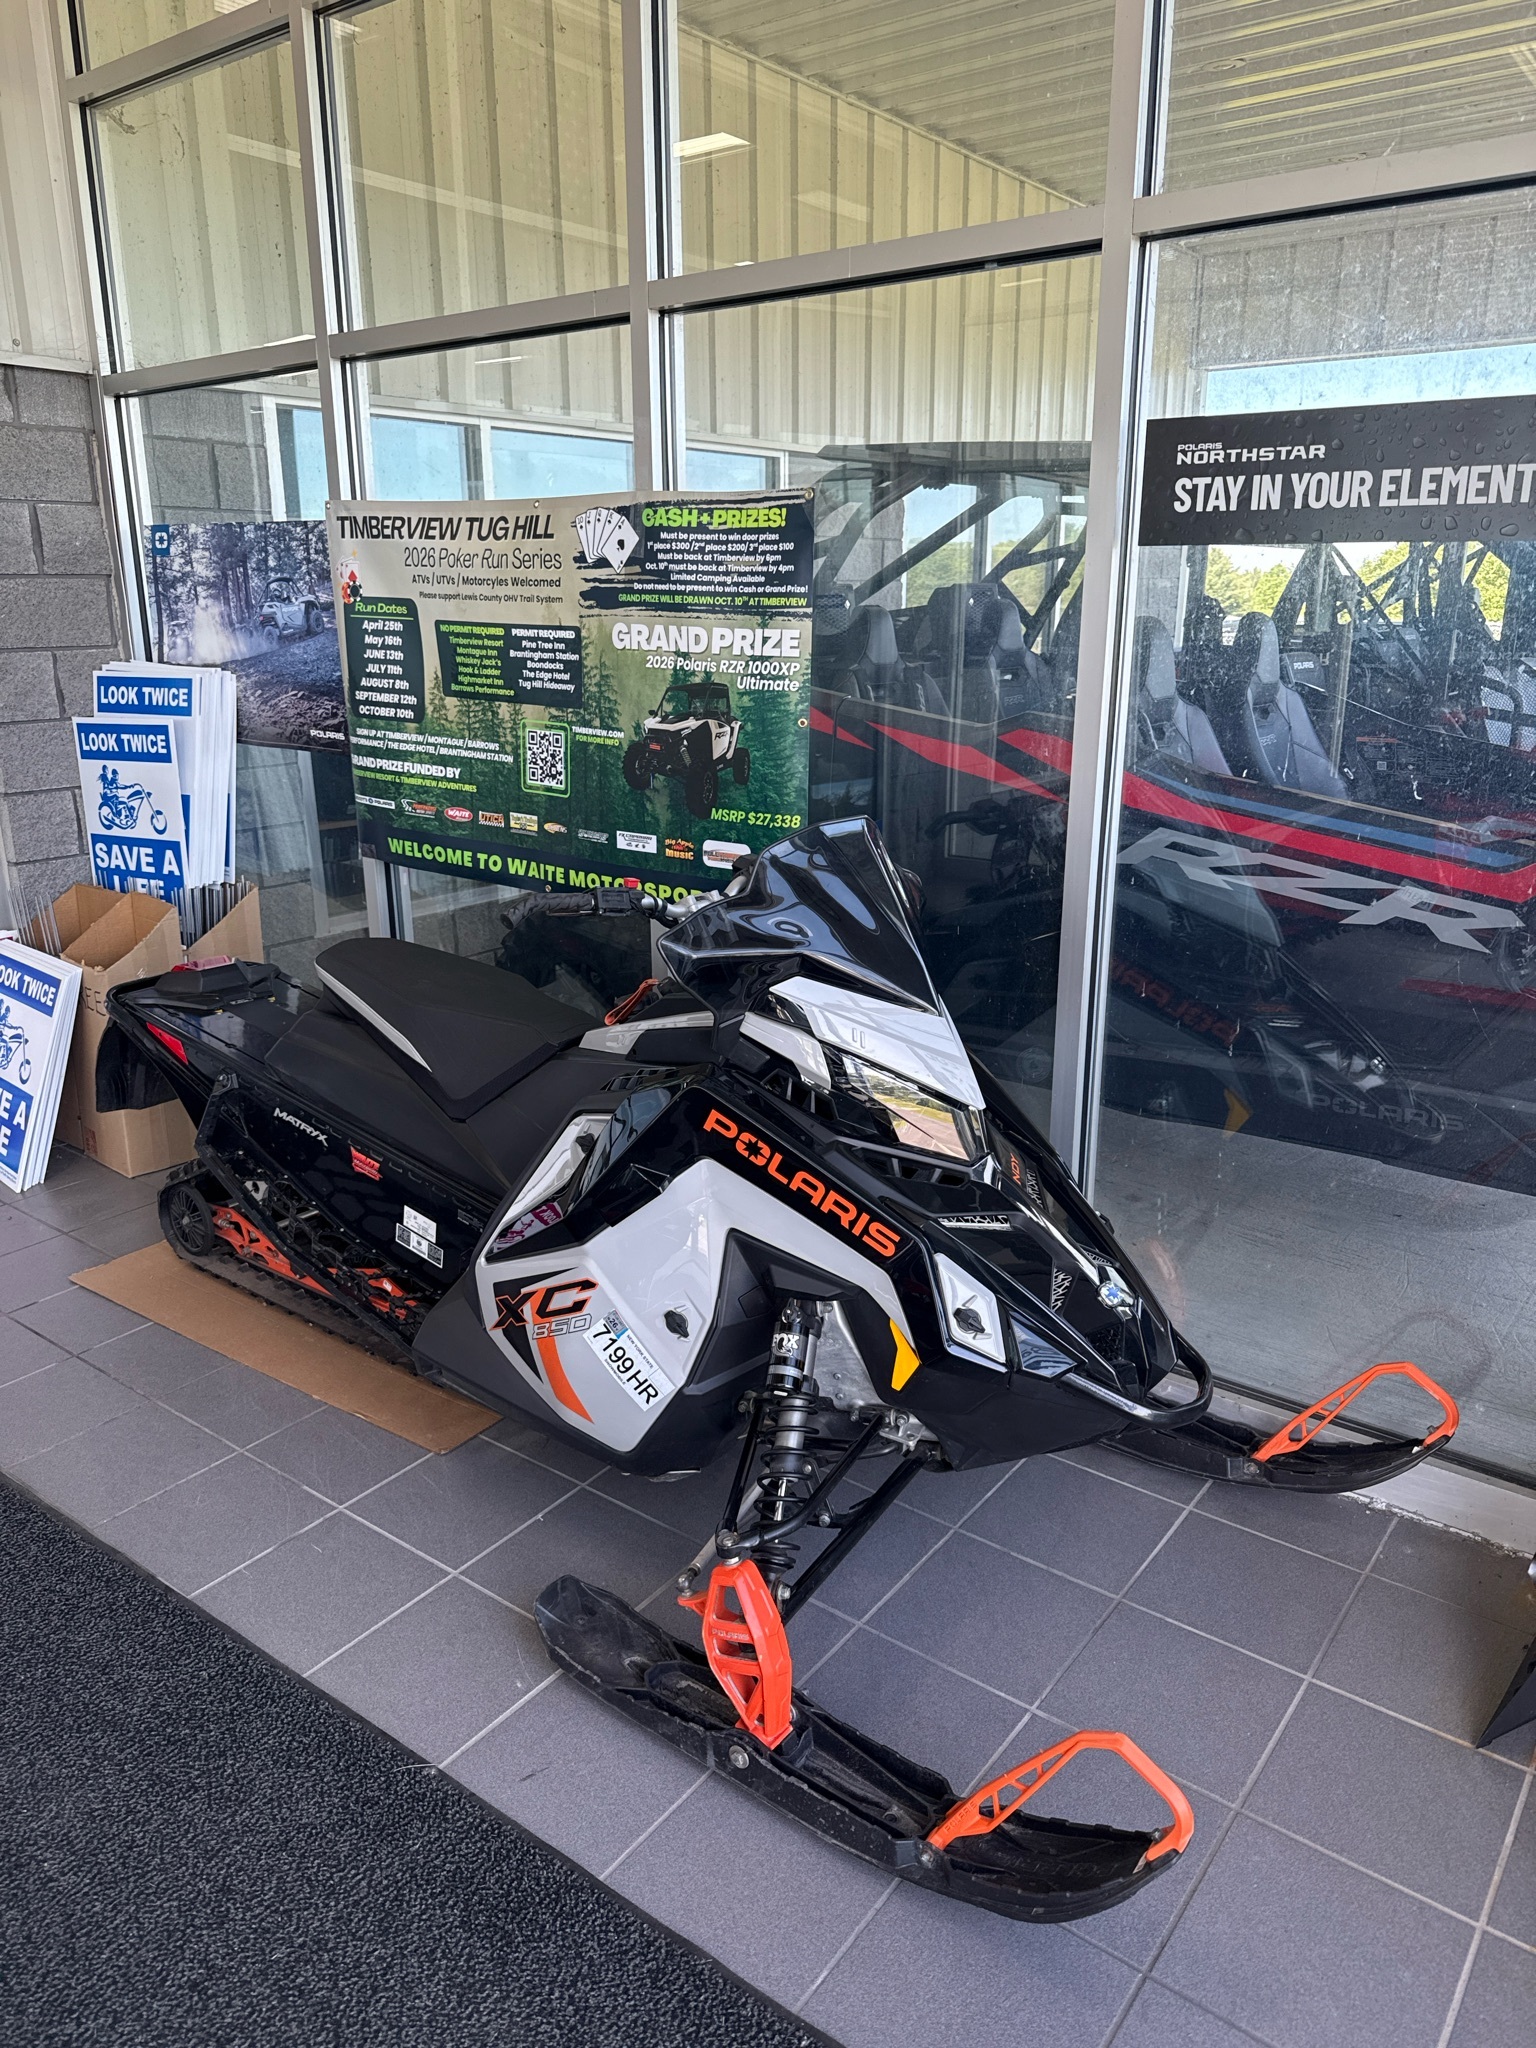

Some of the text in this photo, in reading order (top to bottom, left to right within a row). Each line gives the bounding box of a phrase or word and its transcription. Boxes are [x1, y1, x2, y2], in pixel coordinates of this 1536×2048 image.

[1177, 442, 1223, 452] POLARIS
[1176, 444, 1325, 465] NORTHSTAR
[1173, 463, 1536, 513] STAY IN YOUR ELEMENT
[641, 507, 698, 527] CASH
[712, 507, 787, 528] PRIZES!
[336, 515, 462, 541] TIMBERVIEW
[465, 516, 510, 541] TUG
[511, 514, 555, 540] HILL
[660, 531, 780, 542] Must be present win door prizes
[653, 541, 795, 553] place $300 place place $100
[404, 547, 562, 570] 2026 Poker Run Series
[657, 552, 782, 563] Must back Timberview 6pm
[668, 563, 795, 574] must Timberview 4pm
[412, 574, 561, 589] ATVs UTVs Motorcyles Welcomed
[670, 572, 765, 584] Limited Camping Available
[654, 583, 809, 593] need present Cash Grand Prize!
[419, 591, 563, 606] Please support Lewis County OHV Trail System
[618, 593, 808, 606] GRAND PRIZE DRAWN TIMBERVIEW
[355, 602, 408, 614] Run Dates
[362, 620, 404, 633] April 25th
[450, 625, 505, 636] PERMIT REQUIRED
[364, 634, 403, 647] May 16th
[511, 628, 576, 640] PERMIT REQUIRED
[611, 622, 801, 658] GRAND PRIZE
[449, 636, 504, 647] Timberview Resort
[521, 640, 553, 649] Pine Tree
[363, 649, 404, 661] JUNE 13th
[456, 646, 486, 657] Montague
[509, 649, 580, 661] Brantingham Station
[455, 656, 481, 666] Whiskey
[526, 660, 564, 670] Boondocks
[645, 655, 801, 677] 2026 Polaris RZR 1000XP
[365, 663, 403, 675] JULY 11th
[480, 667, 501, 676] Ladder
[522, 669, 571, 681] The Edge Hotel
[360, 677, 410, 690] AUGUST 8th
[458, 675, 493, 685] Highmarket
[518, 679, 576, 693] Tug Hideaway
[736, 675, 800, 692] Ultimate
[100, 685, 189, 707] LOOK TWICE
[451, 683, 515, 696] Barrows Performance
[355, 690, 417, 706] SEPTEMBER 12th
[359, 705, 414, 719] OCTOBER 10th
[310, 729, 345, 741] POLARIS
[571, 725, 625, 739] TIMBERVIEW.COM
[80, 732, 167, 754] LOOK TWICE
[385, 731, 500, 751] TIMBERVIEW MONTAGUE BARROWS
[588, 735, 619, 746] MORE INFO
[439, 747, 514, 763] BRANTINGHAM STATION
[376, 758, 461, 779] PRIZE FUNDED BY
[400, 776, 477, 793] TIMBERVIEW ADVENTURES
[710, 808, 801, 828] MSRP $27,338
[95, 842, 181, 876] SAVE A
[387, 837, 473, 868] WELCOME
[476, 852, 502, 872] TO
[507, 857, 566, 884] WAITE
[22, 974, 57, 1007] TWICE
[13, 1100, 26, 1131] A
[273, 1107, 329, 1148] MATRYX
[703, 1109, 900, 1257] POLARIS
[489, 1277, 600, 1332] XC
[532, 1313, 593, 1340] 850
[772, 1333, 800, 1351] FOX
[944, 1800, 978, 1833] POLARIS
